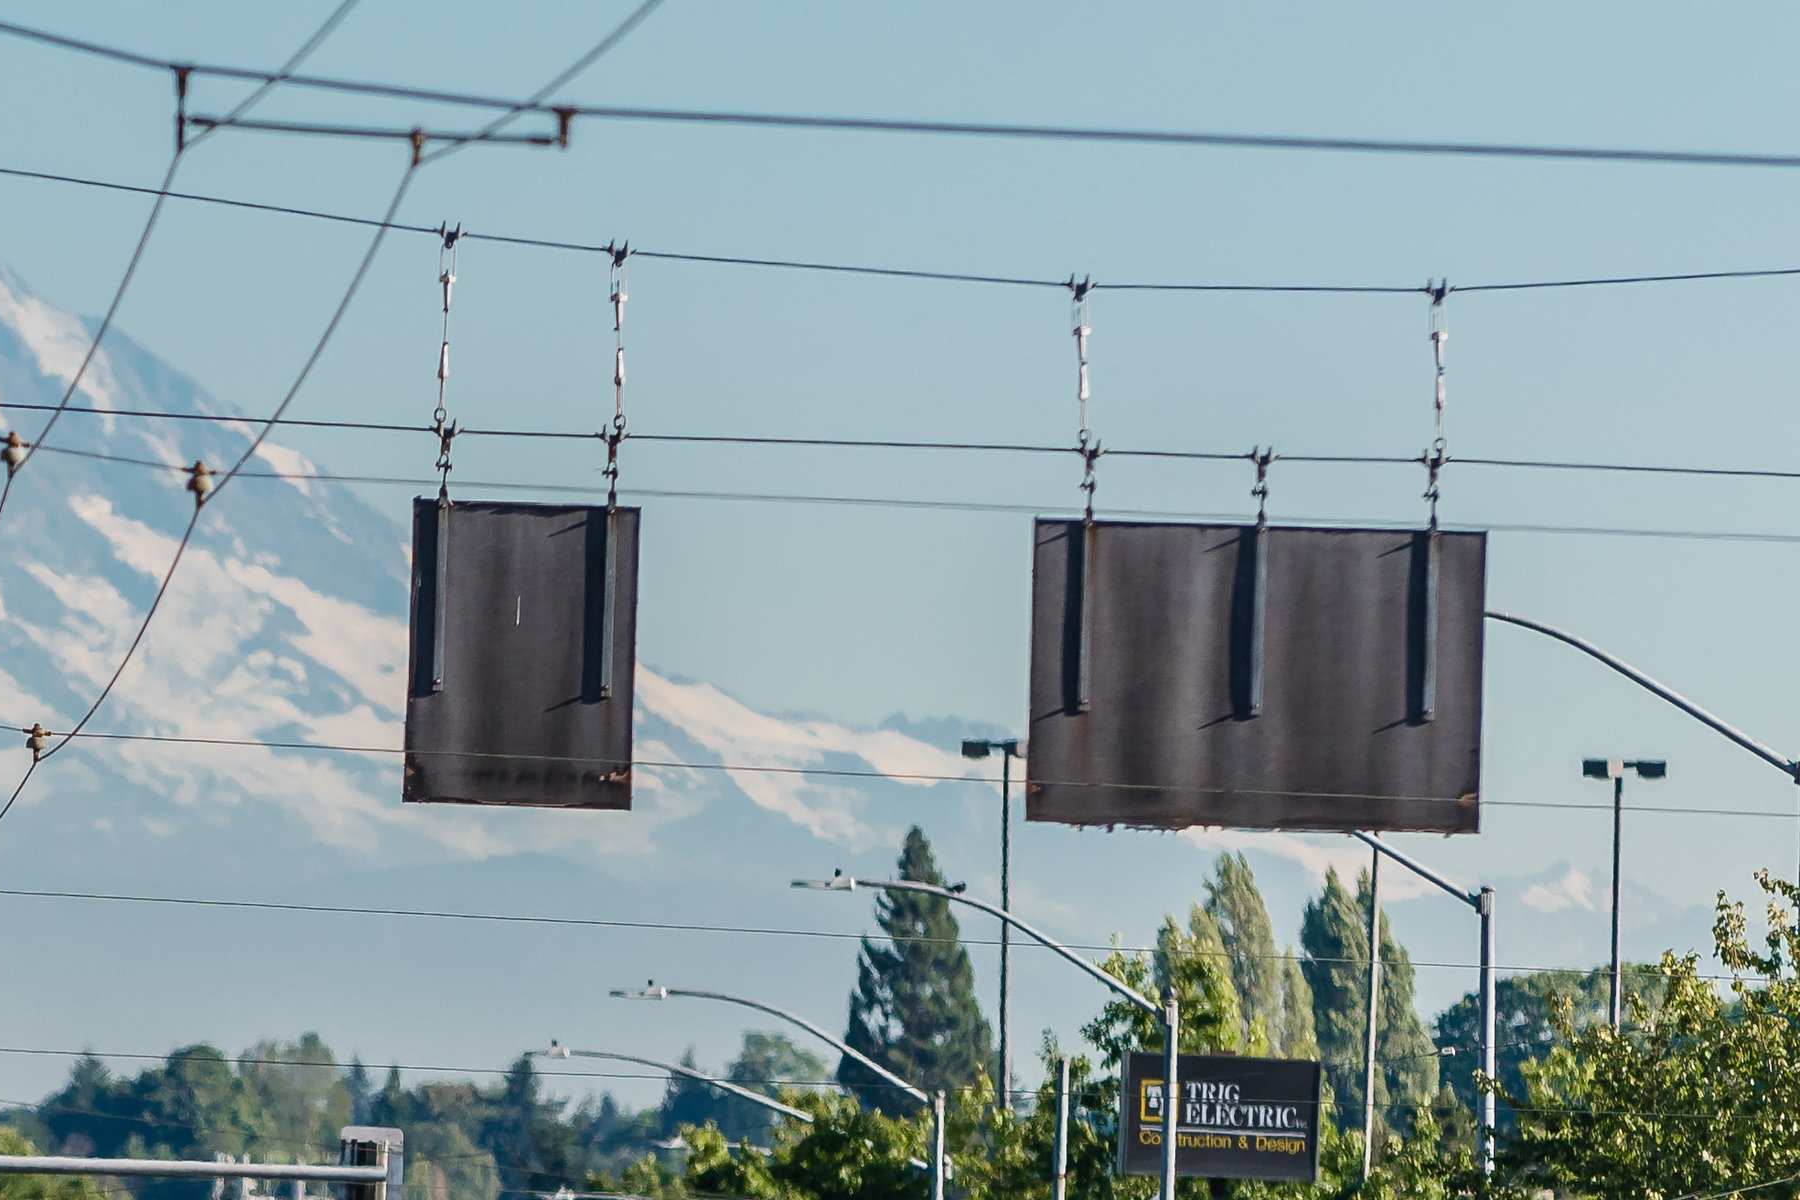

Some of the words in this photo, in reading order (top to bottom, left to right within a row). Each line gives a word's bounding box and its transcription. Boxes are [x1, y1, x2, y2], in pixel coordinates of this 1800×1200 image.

[1185, 1080, 1241, 1103] TRIG
[1185, 1103, 1297, 1129] ELECTRIC
[1238, 1136, 1248, 1150] &
[1255, 1137, 1306, 1155] Design
